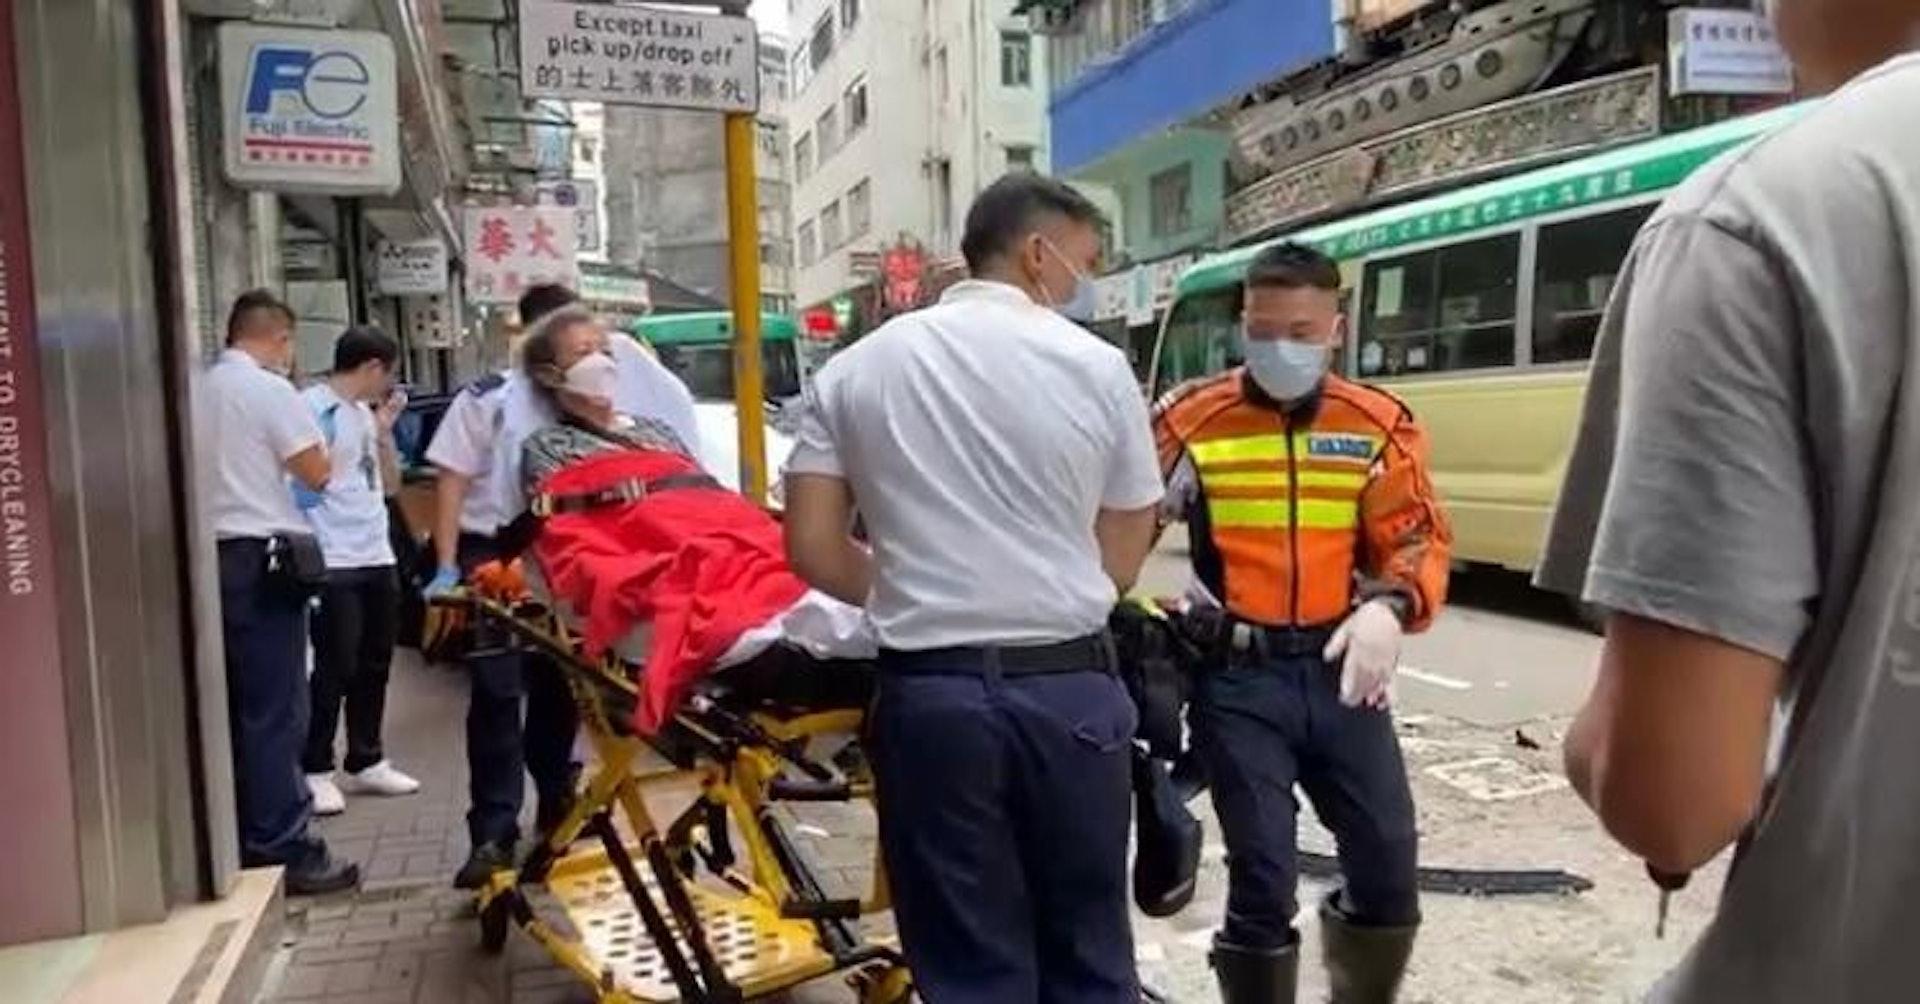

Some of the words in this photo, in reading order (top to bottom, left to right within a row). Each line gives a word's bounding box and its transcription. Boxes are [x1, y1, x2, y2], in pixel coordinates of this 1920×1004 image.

[575, 10, 654, 37] Except
[661, 20, 703, 39] taxi
[547, 34, 593, 57] pick
[603, 40, 695, 66] up/drop
[700, 46, 735, 66] off
[249, 117, 288, 139] Fuji
